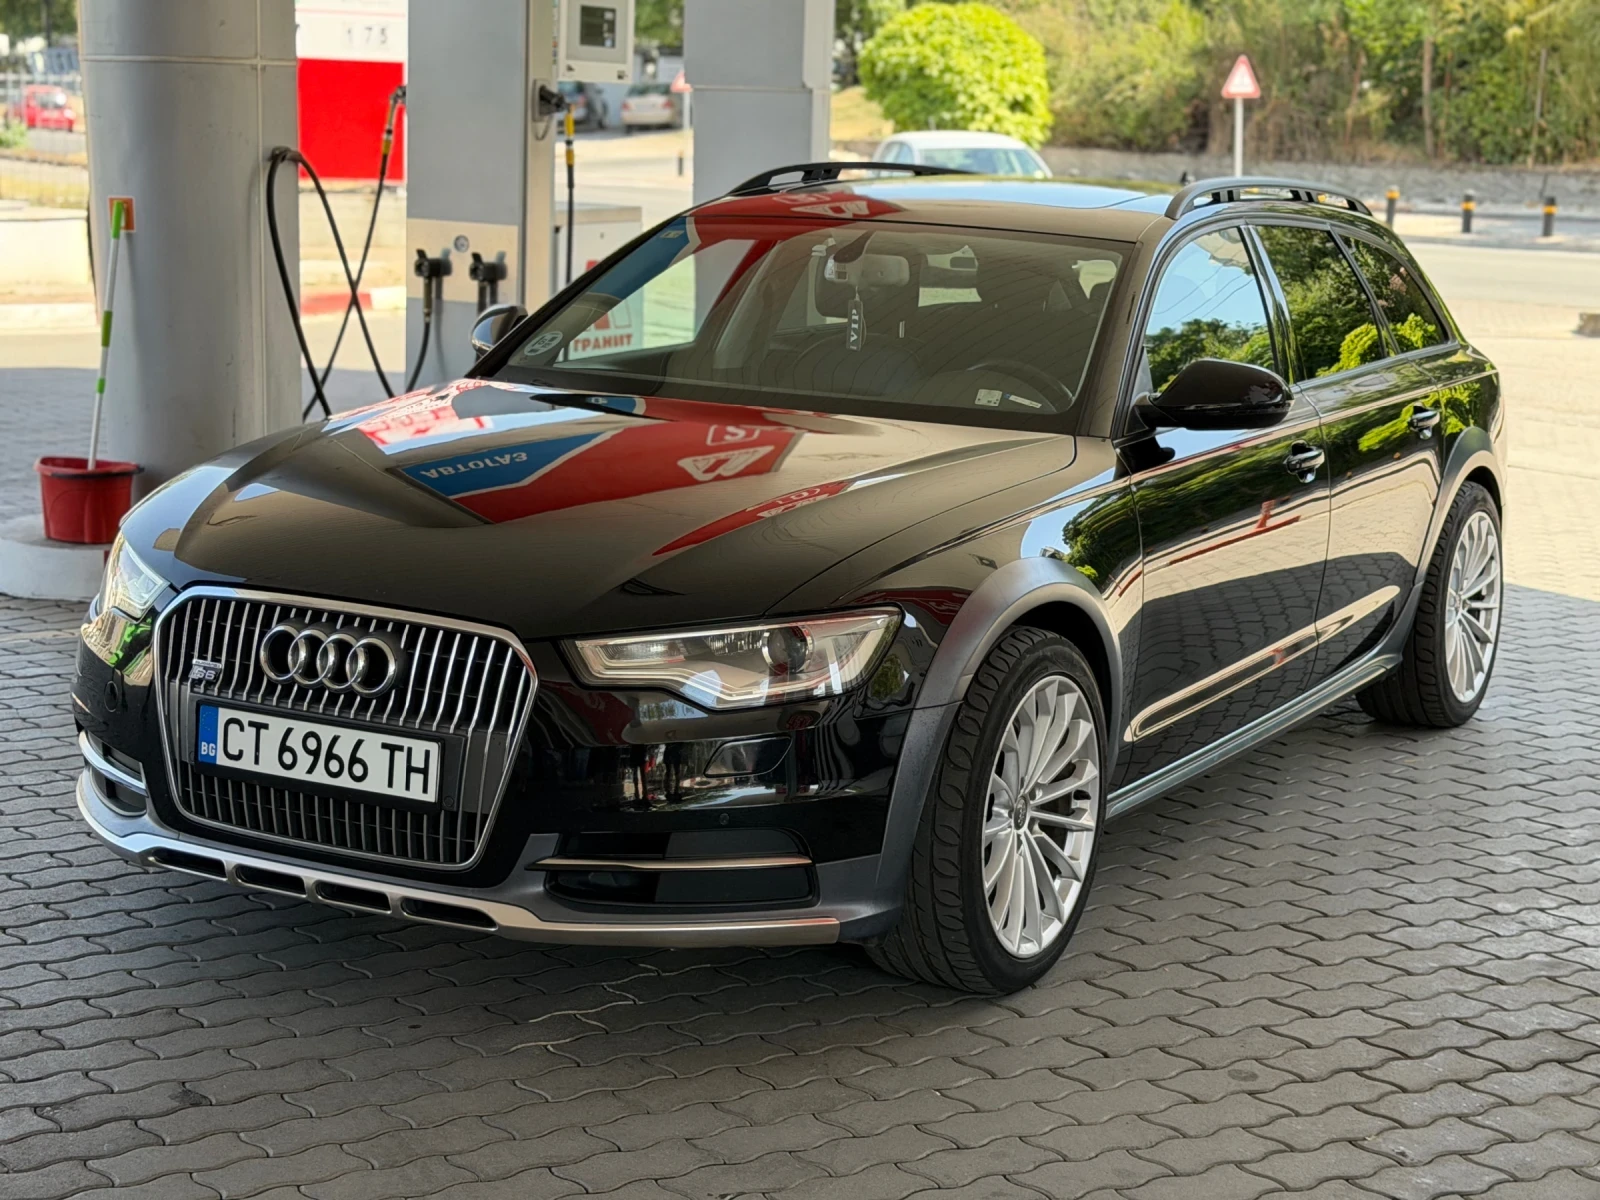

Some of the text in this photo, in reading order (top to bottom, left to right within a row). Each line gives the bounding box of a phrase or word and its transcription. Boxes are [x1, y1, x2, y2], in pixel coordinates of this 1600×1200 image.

[850, 308, 859, 343] VIP
[573, 333, 633, 352] ГРАНИТ
[200, 741, 216, 757] BG
[222, 717, 431, 795] CT 6966 TH
